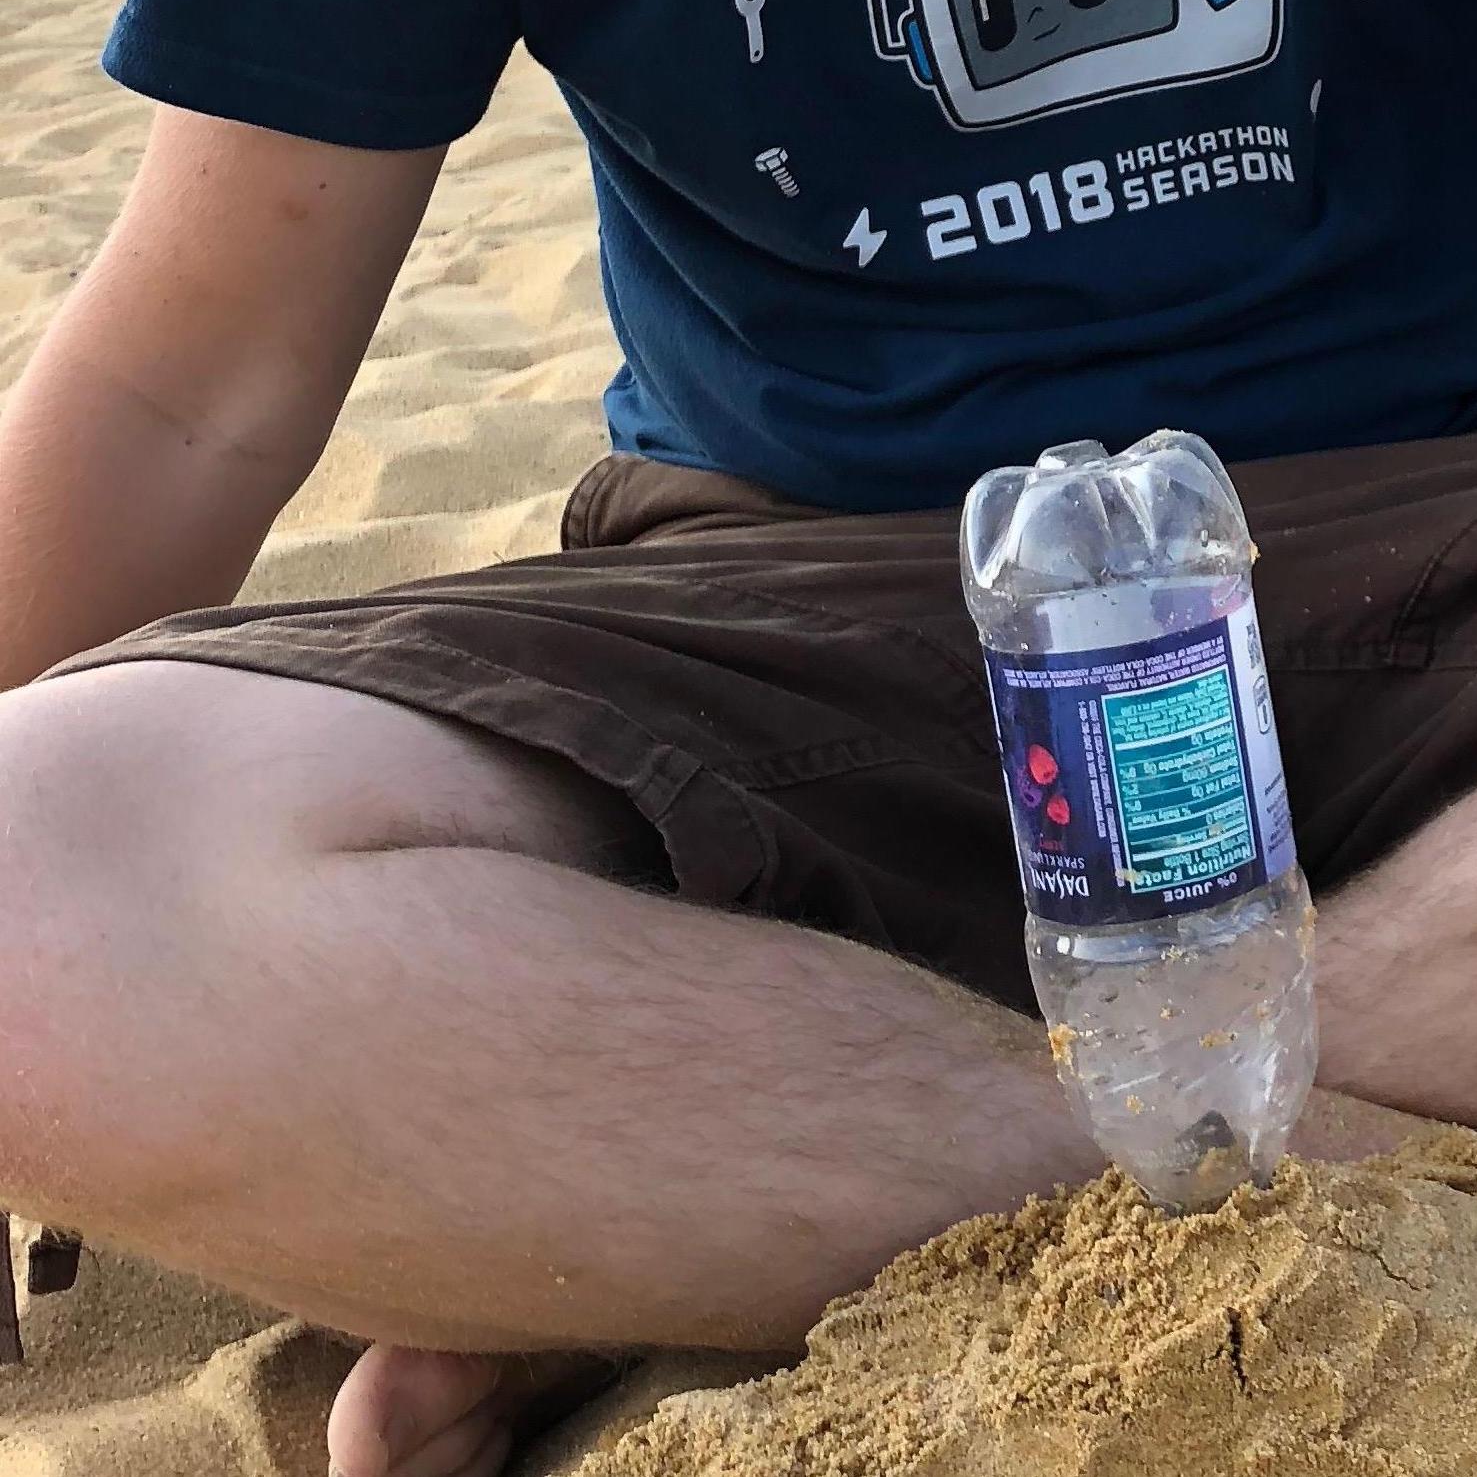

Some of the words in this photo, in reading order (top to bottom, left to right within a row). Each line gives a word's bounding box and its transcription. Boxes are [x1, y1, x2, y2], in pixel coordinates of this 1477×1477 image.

[1116, 125, 1291, 174] HACKATHON
[1122, 152, 1295, 213] SEASON
[920, 158, 1115, 261] 2018
[1187, 844, 1252, 876] Nutrition
[1030, 867, 1091, 901] DASANI
[1162, 881, 1214, 903] JUICE
[1216, 871, 1239, 889] 0%
